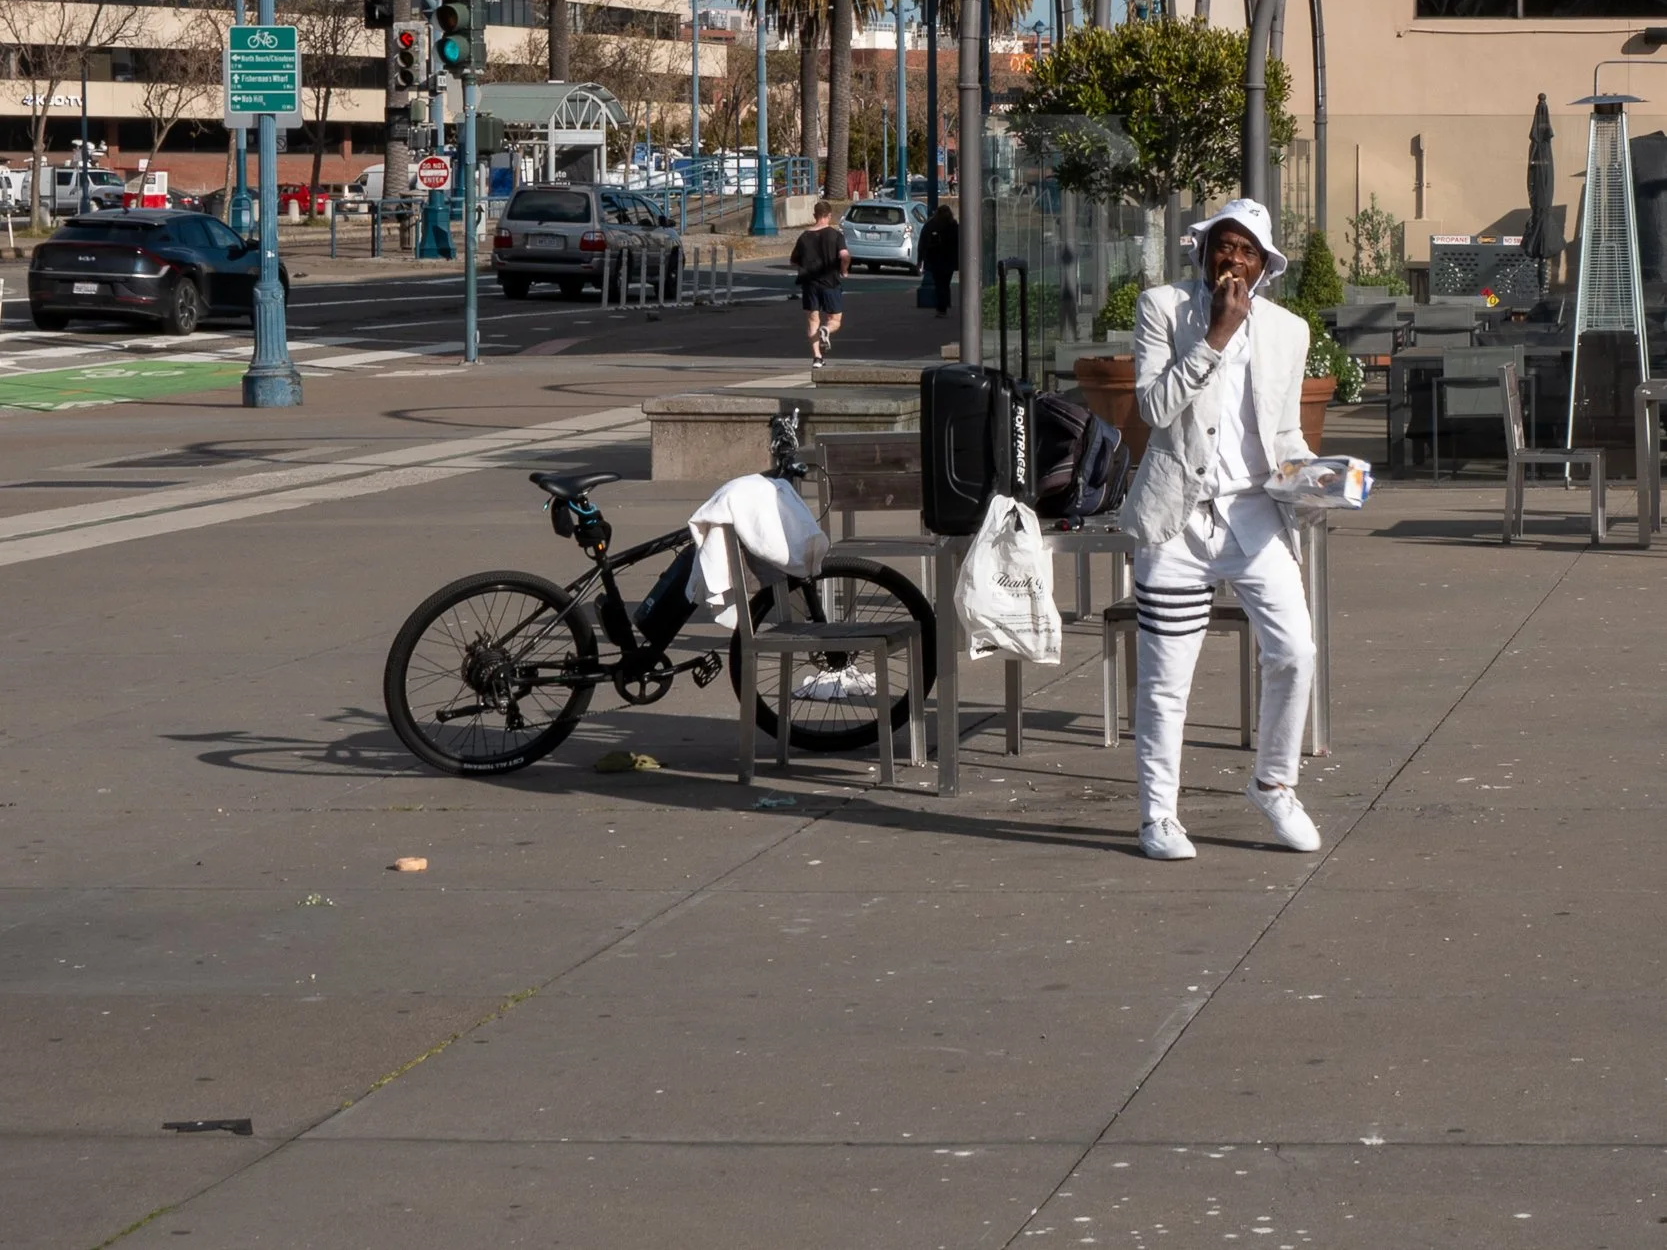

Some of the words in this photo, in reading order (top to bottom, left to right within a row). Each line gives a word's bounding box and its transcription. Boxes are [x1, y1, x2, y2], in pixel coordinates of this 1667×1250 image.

[241, 74, 272, 82] Fisherman's
[273, 74, 288, 82] Wharf
[1436, 236, 1468, 244] PROPANE
[1015, 405, 1026, 485] BONTRAGER
[992, 571, 1033, 588] Thank
